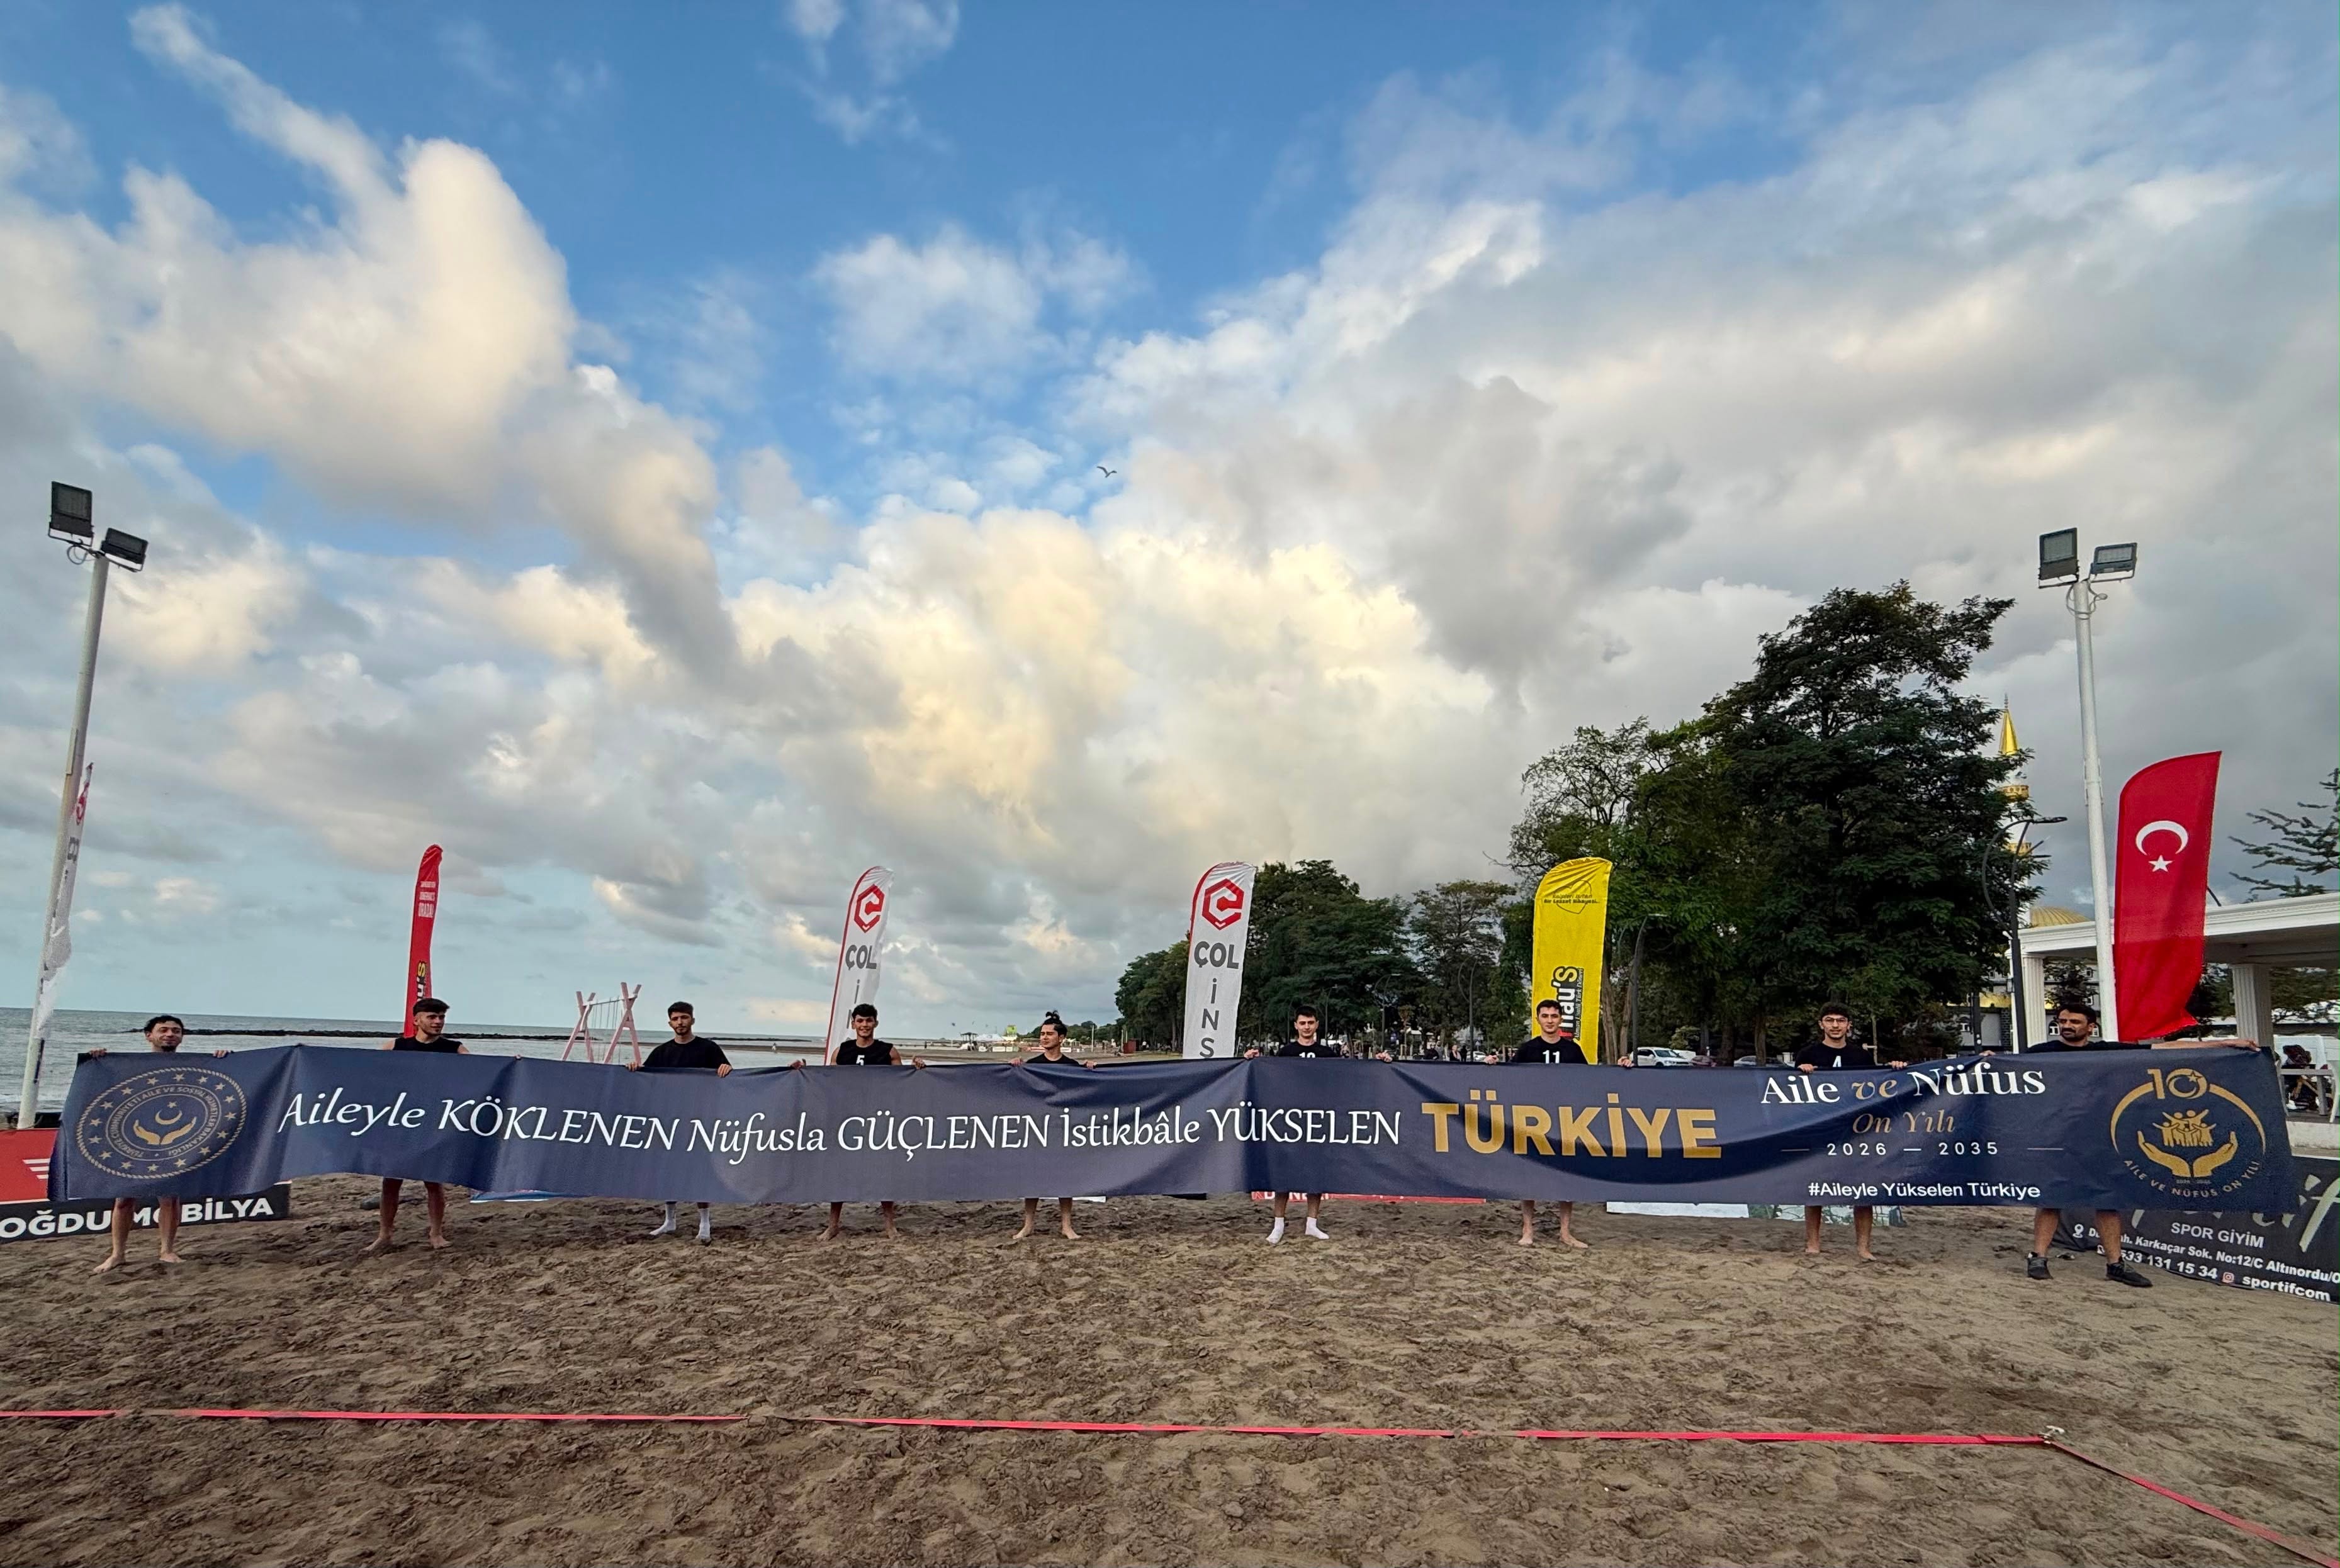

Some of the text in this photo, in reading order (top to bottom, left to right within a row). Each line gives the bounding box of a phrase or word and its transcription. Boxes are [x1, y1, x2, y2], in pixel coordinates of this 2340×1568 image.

[1543, 1050, 1560, 1063] 11
[1761, 1061, 2047, 1104] Aile ve Nüfus
[278, 1087, 1721, 1165] Aileyle KÖKLENEN Nüfusla GÜÇLENEN İstikbâle YÜKSELEN TÜRKİYE
[1852, 1110, 1956, 1134] On Yılı
[1826, 1142, 1998, 1156] 2026 2035
[1808, 1182, 2041, 1199] #Aileyle Yükselen Türkiye
[2151, 1179, 2166, 1192] VE
[2222, 1179, 2242, 1192] ON
[2241, 1160, 2261, 1180] YILI
[133, 1197, 274, 1226] MBİLYA
[2171, 1223, 2264, 1249] SPOR GİYİM
[2135, 1236, 2186, 1255] Karkaçar
[2188, 1245, 2213, 1260] Sok.
[2215, 1251, 2263, 1268] No:12/C
[2120, 1249, 2331, 1302] 533 131 15 34 sportifcom
